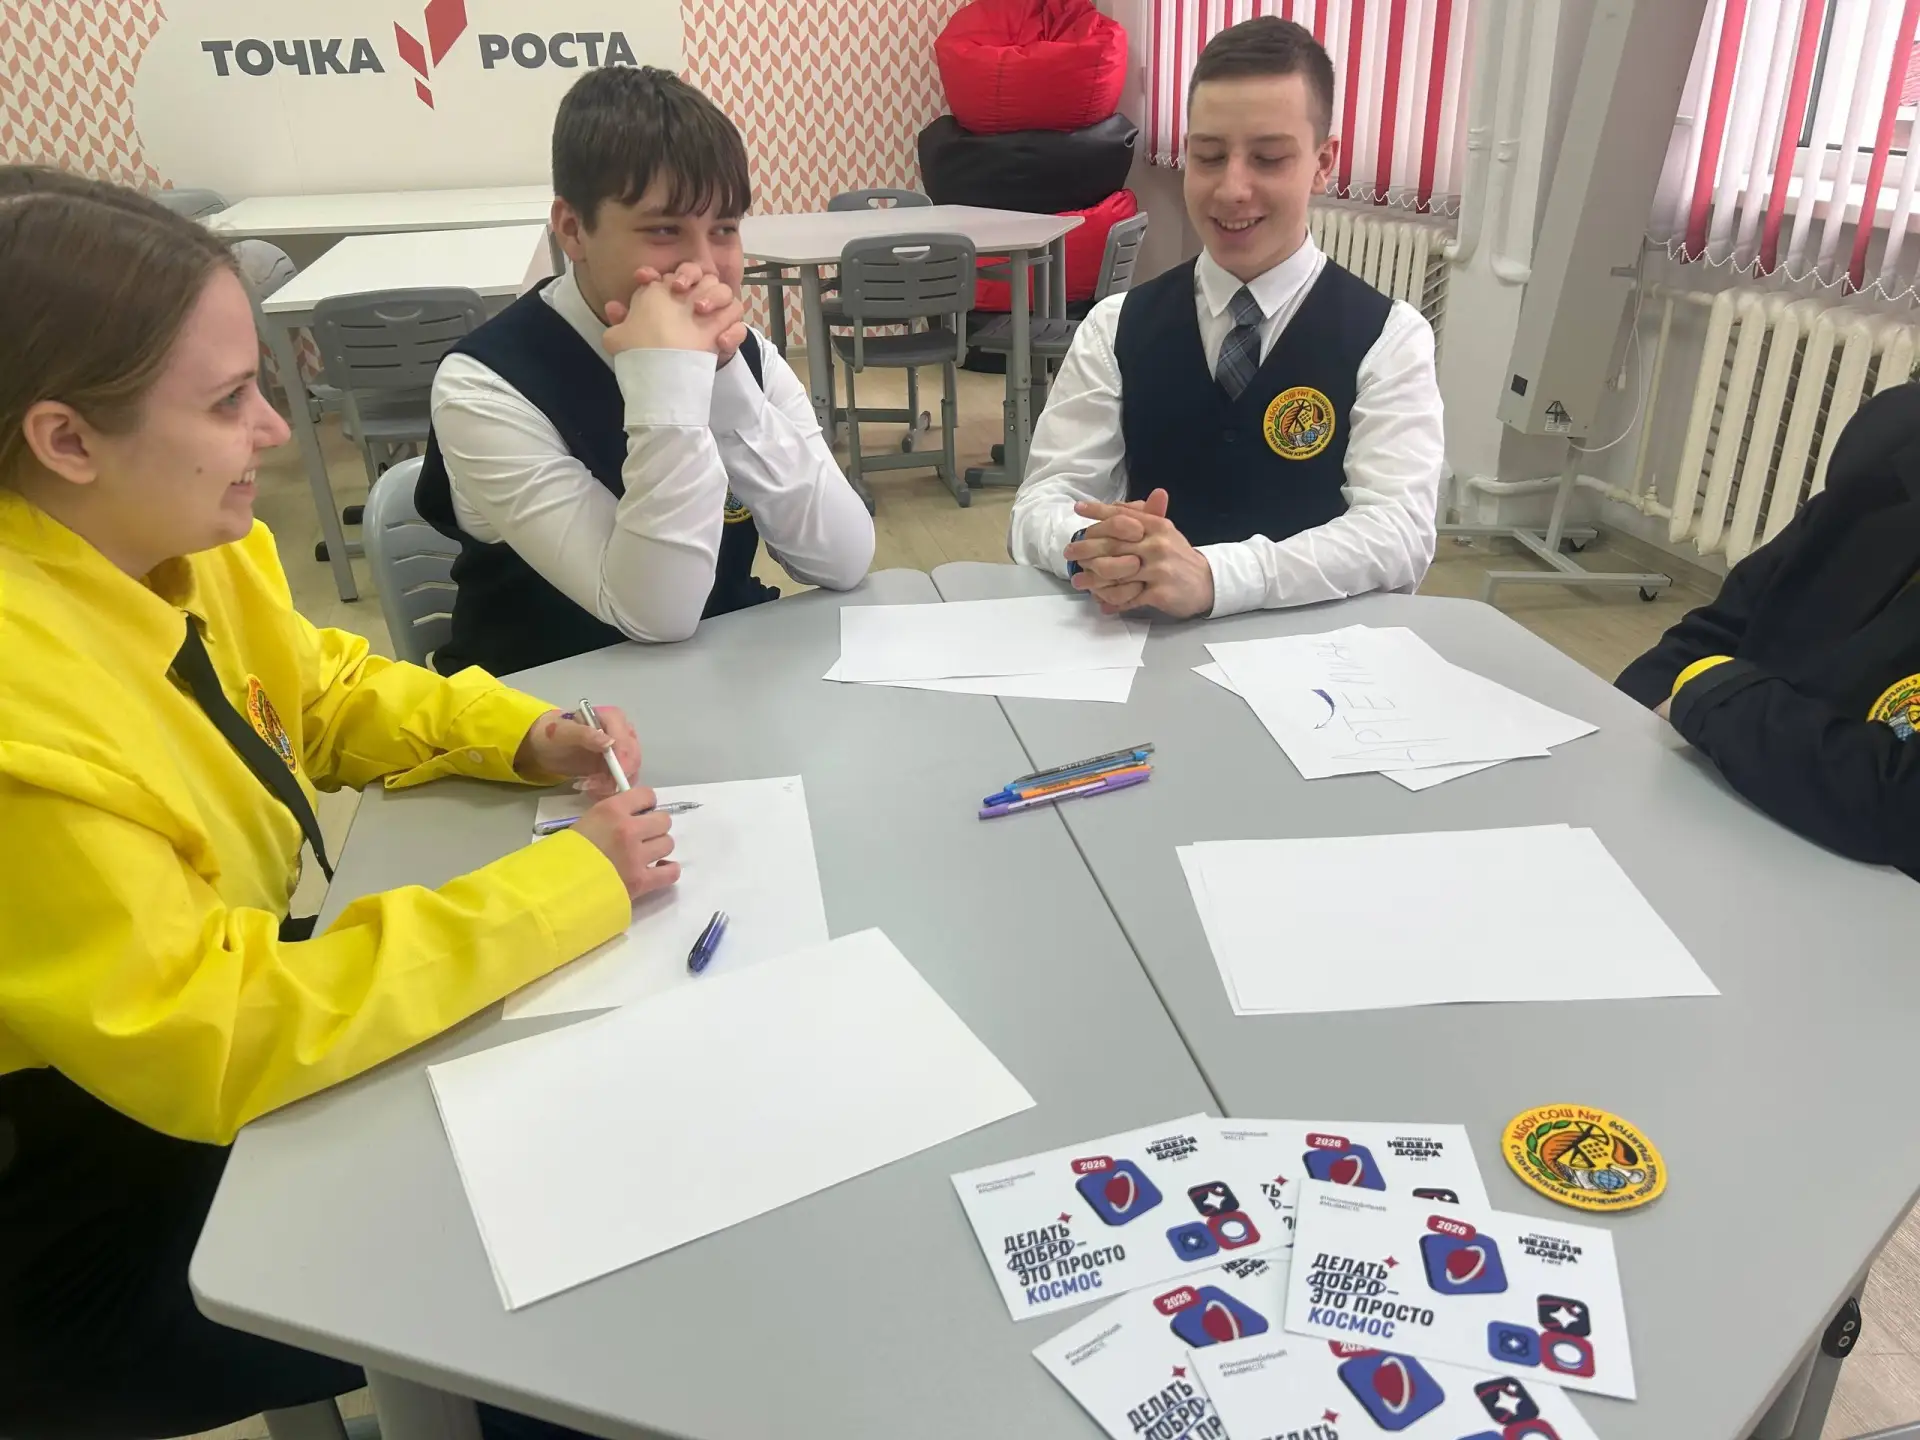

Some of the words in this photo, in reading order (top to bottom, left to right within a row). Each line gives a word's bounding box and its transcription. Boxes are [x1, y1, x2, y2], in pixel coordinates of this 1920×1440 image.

[200, 38, 385, 76] ТОЧКА
[478, 31, 638, 69] РОСТА
[1512, 1115, 1538, 1141] МБОУ
[1539, 1108, 1575, 1120] СОШ
[1578, 1109, 1603, 1123] №1
[1145, 1136, 1198, 1154] НЕДЕЛЯ
[1156, 1145, 1199, 1160] ДОБРА
[1314, 1136, 1342, 1149] 2026
[1386, 1140, 1444, 1150] НЕДЕЛЯ
[1394, 1149, 1442, 1158] ДОБРА
[1080, 1159, 1107, 1171] 2026
[1004, 1224, 1070, 1254] ДЕЛАТЬ
[1436, 1219, 1467, 1236] 2026
[1010, 1240, 1072, 1271] ДОБРО
[1518, 1236, 1582, 1255] НЕДЕЛЯ
[1524, 1246, 1578, 1263] ДОБРА
[1018, 1264, 1051, 1286] ЭТО
[1056, 1244, 1126, 1277] ПРОСТО
[1311, 1252, 1389, 1280] ДЕЛАТЬ
[1026, 1270, 1102, 1304] КОСМОС
[1309, 1270, 1381, 1296] ДОБРО
[1163, 1290, 1193, 1311] 2026
[1309, 1287, 1348, 1309] ЭТО
[1352, 1296, 1435, 1327] ПРОСТО
[1307, 1306, 1396, 1339] КОСМОС
[1126, 1380, 1194, 1434] ДЕЛАТЬ
